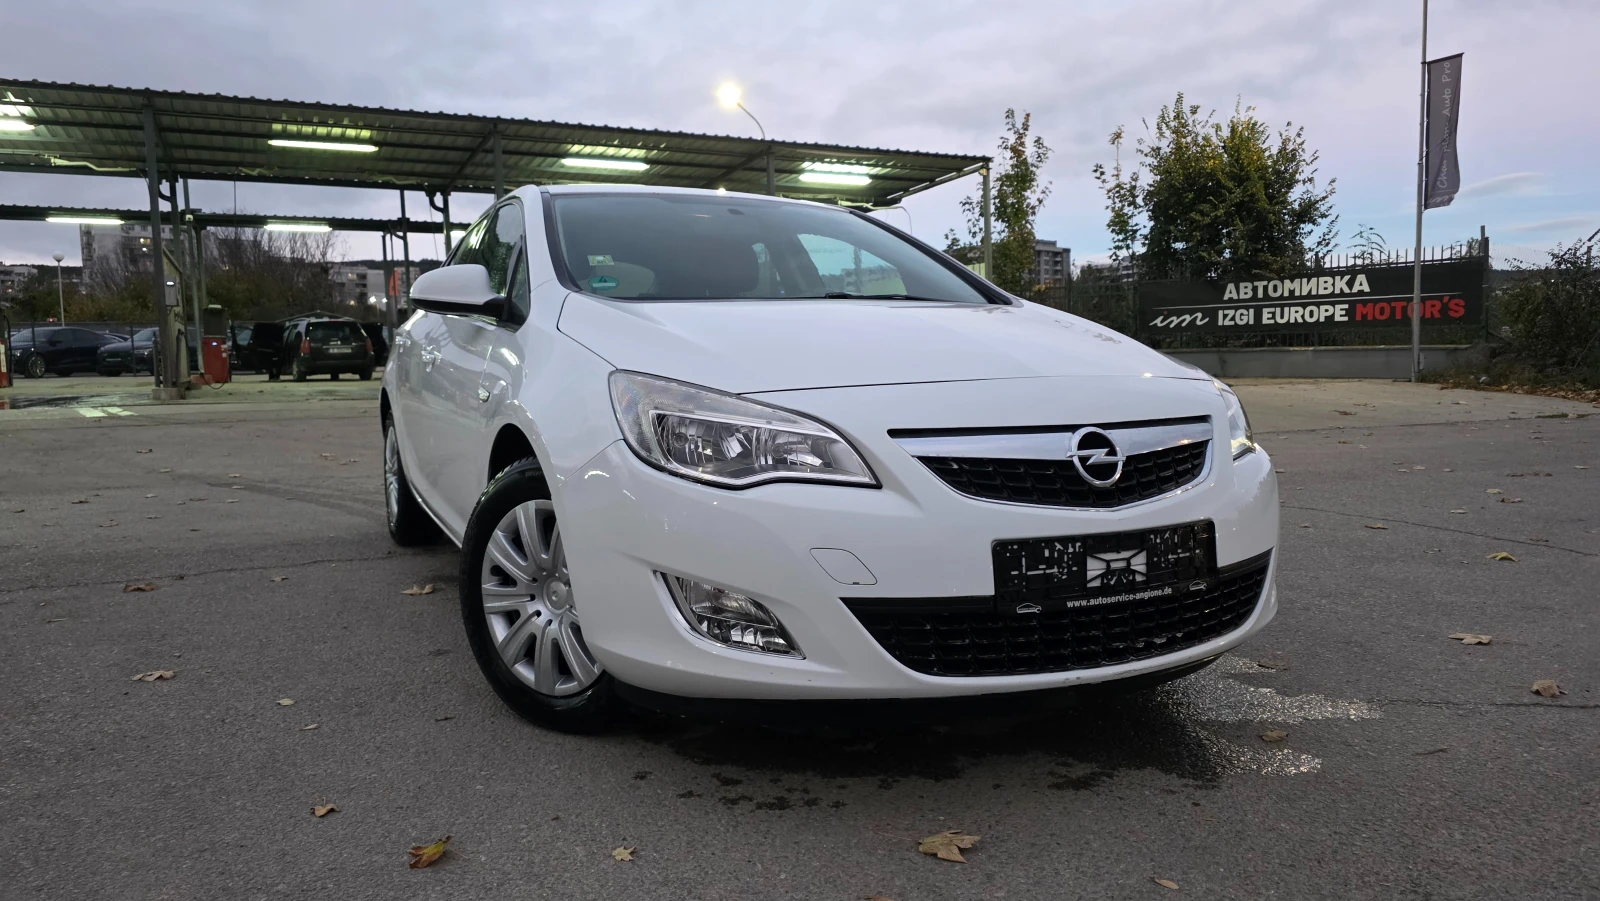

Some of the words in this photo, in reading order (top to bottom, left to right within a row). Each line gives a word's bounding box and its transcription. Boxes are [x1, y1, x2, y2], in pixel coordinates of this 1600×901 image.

[1441, 61, 1451, 83] Pro
[1441, 88, 1451, 117] Auto
[1223, 273, 1371, 301] АВТОМИВКА
[1217, 308, 1255, 326] IZGI
[1262, 304, 1349, 325] EUROPE
[1066, 586, 1173, 608] www.autoservice-angione.de
